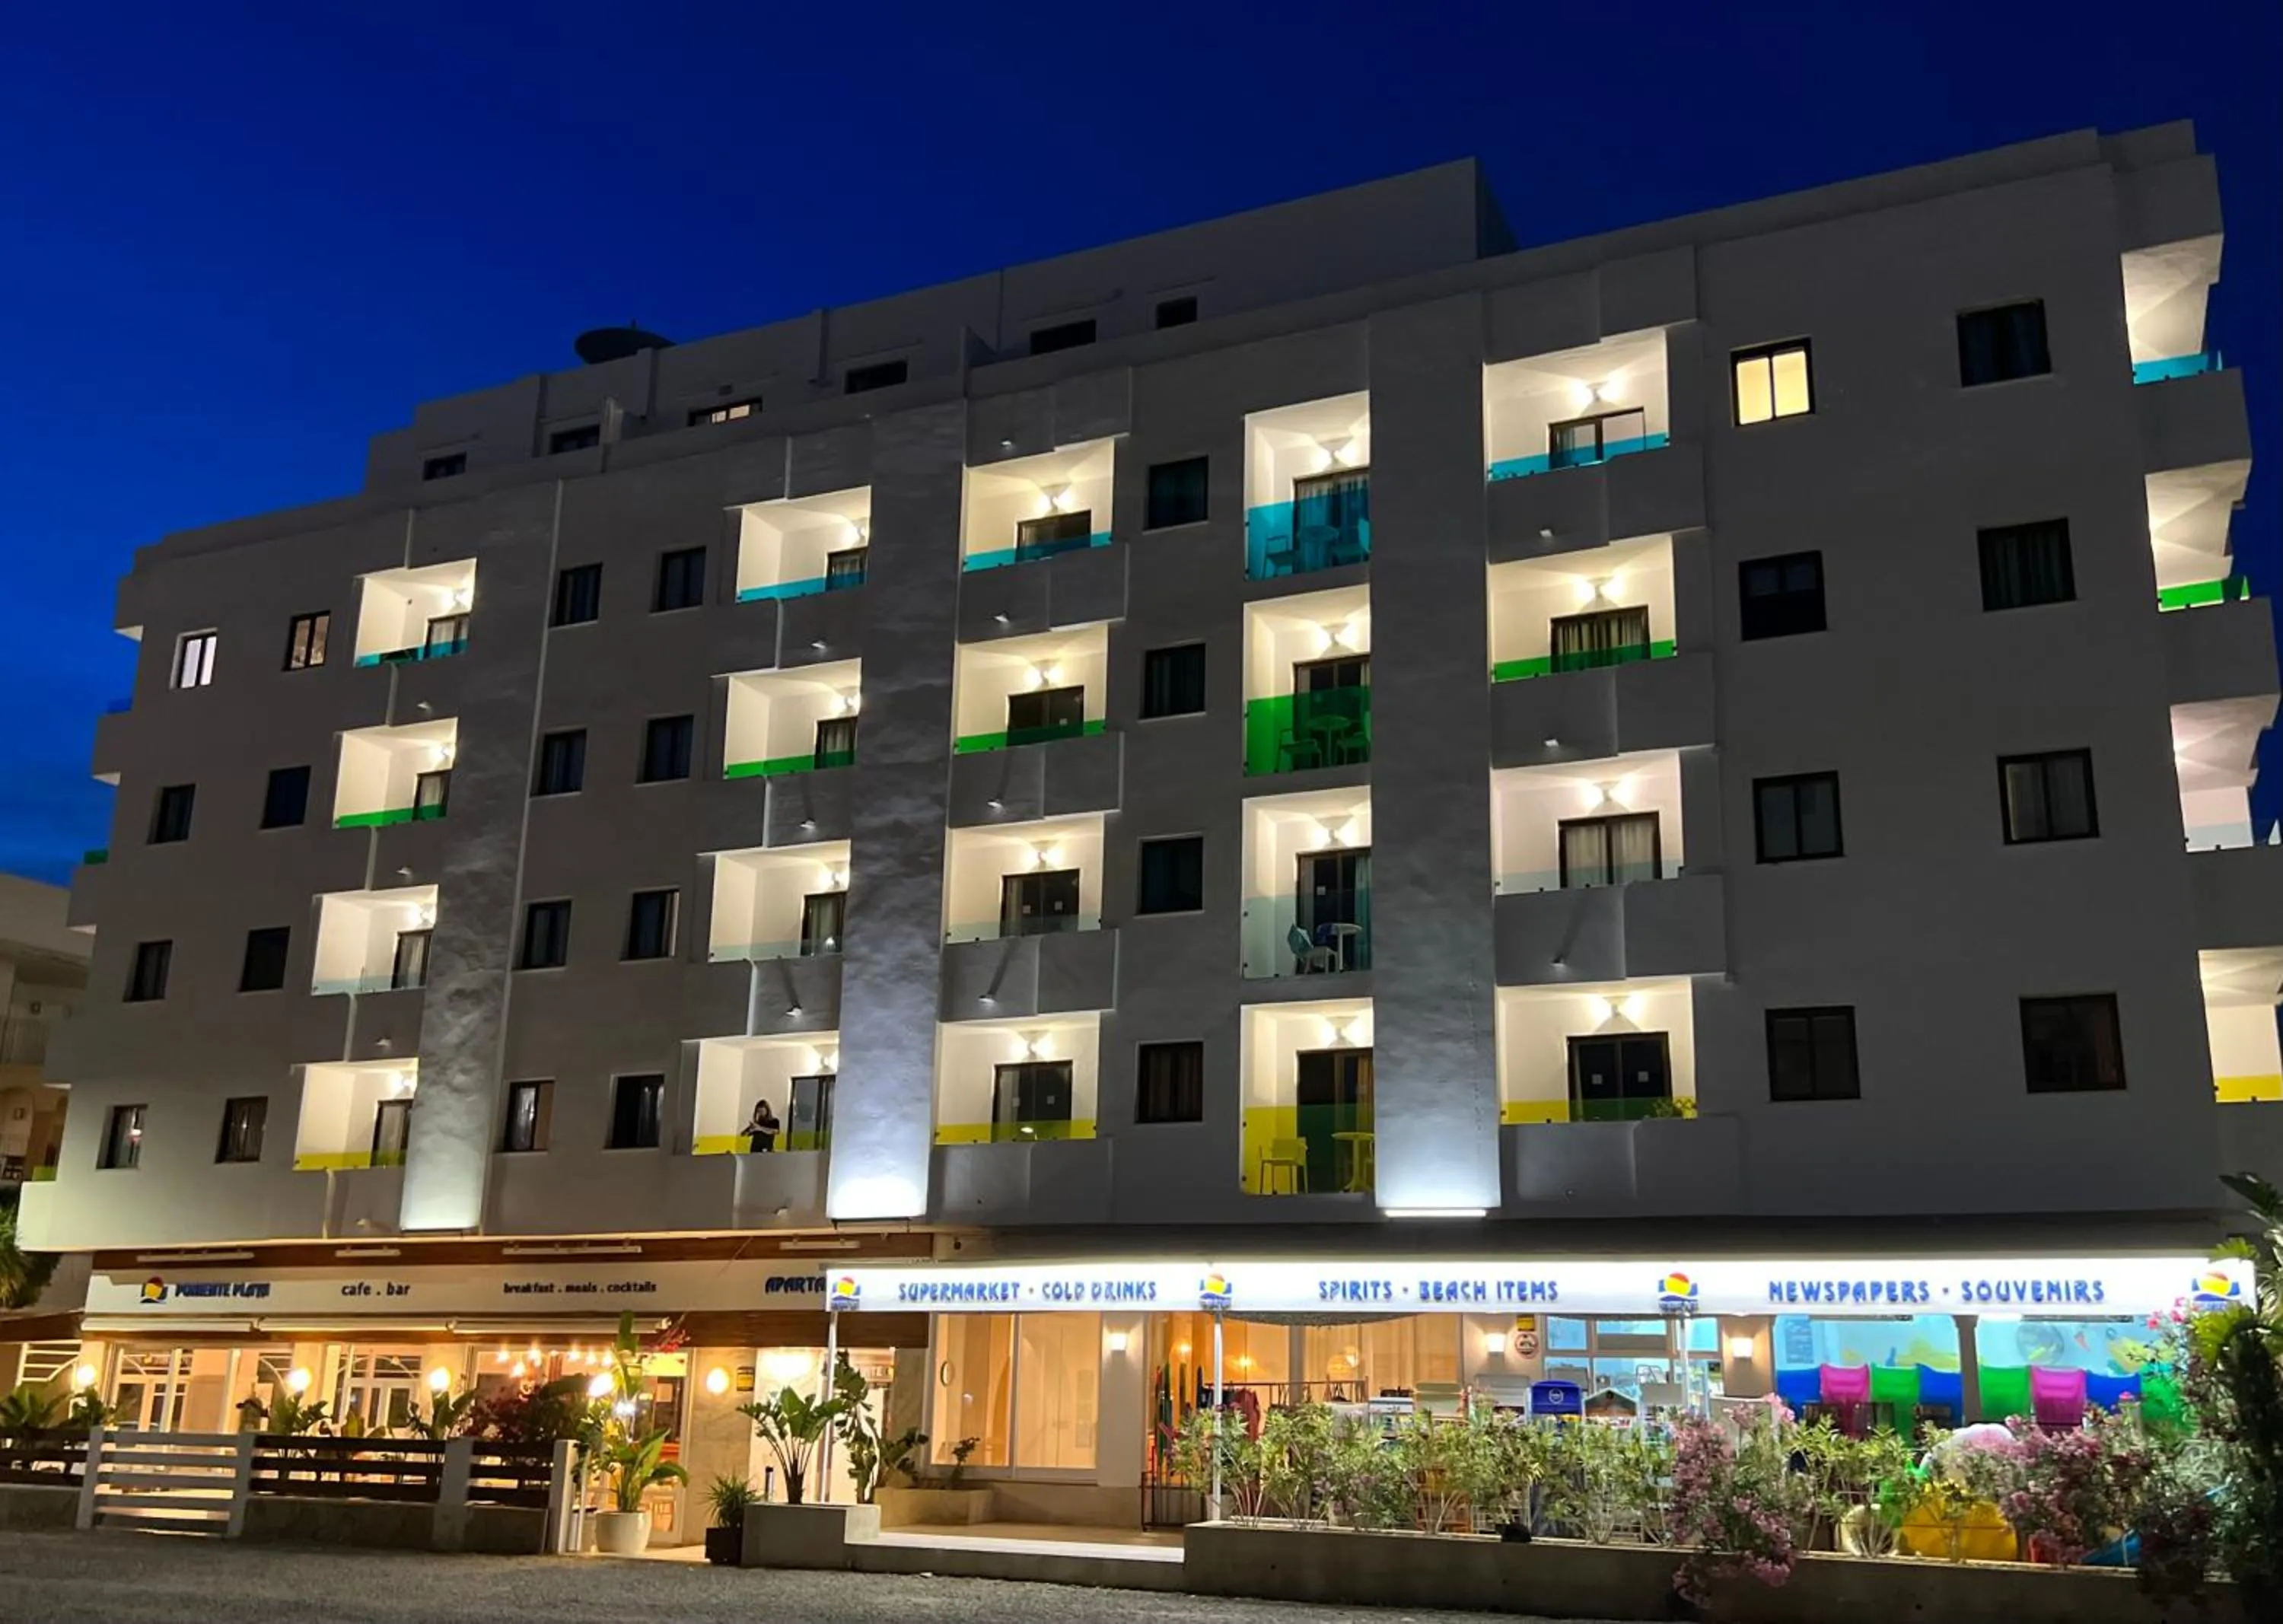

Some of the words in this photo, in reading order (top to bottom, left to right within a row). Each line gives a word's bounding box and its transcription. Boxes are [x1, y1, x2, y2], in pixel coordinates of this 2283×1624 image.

[341, 1281, 371, 1295] cafe
[386, 1281, 410, 1295] bar
[503, 1282, 555, 1293] breakfast
[565, 1282, 597, 1293] meals
[607, 1281, 657, 1293] cocktails
[898, 1282, 1021, 1302] SUPERMARKET
[1042, 1281, 1084, 1301] COLD
[1091, 1281, 1157, 1301] DRINKS
[1319, 1281, 1393, 1301] SPIRITS
[1419, 1281, 1486, 1301] BEACH
[1496, 1281, 1559, 1301] ITEMS
[1769, 1281, 1930, 1302] NEWSPAPERS
[1961, 1281, 2105, 1302] SOUVENIRS
